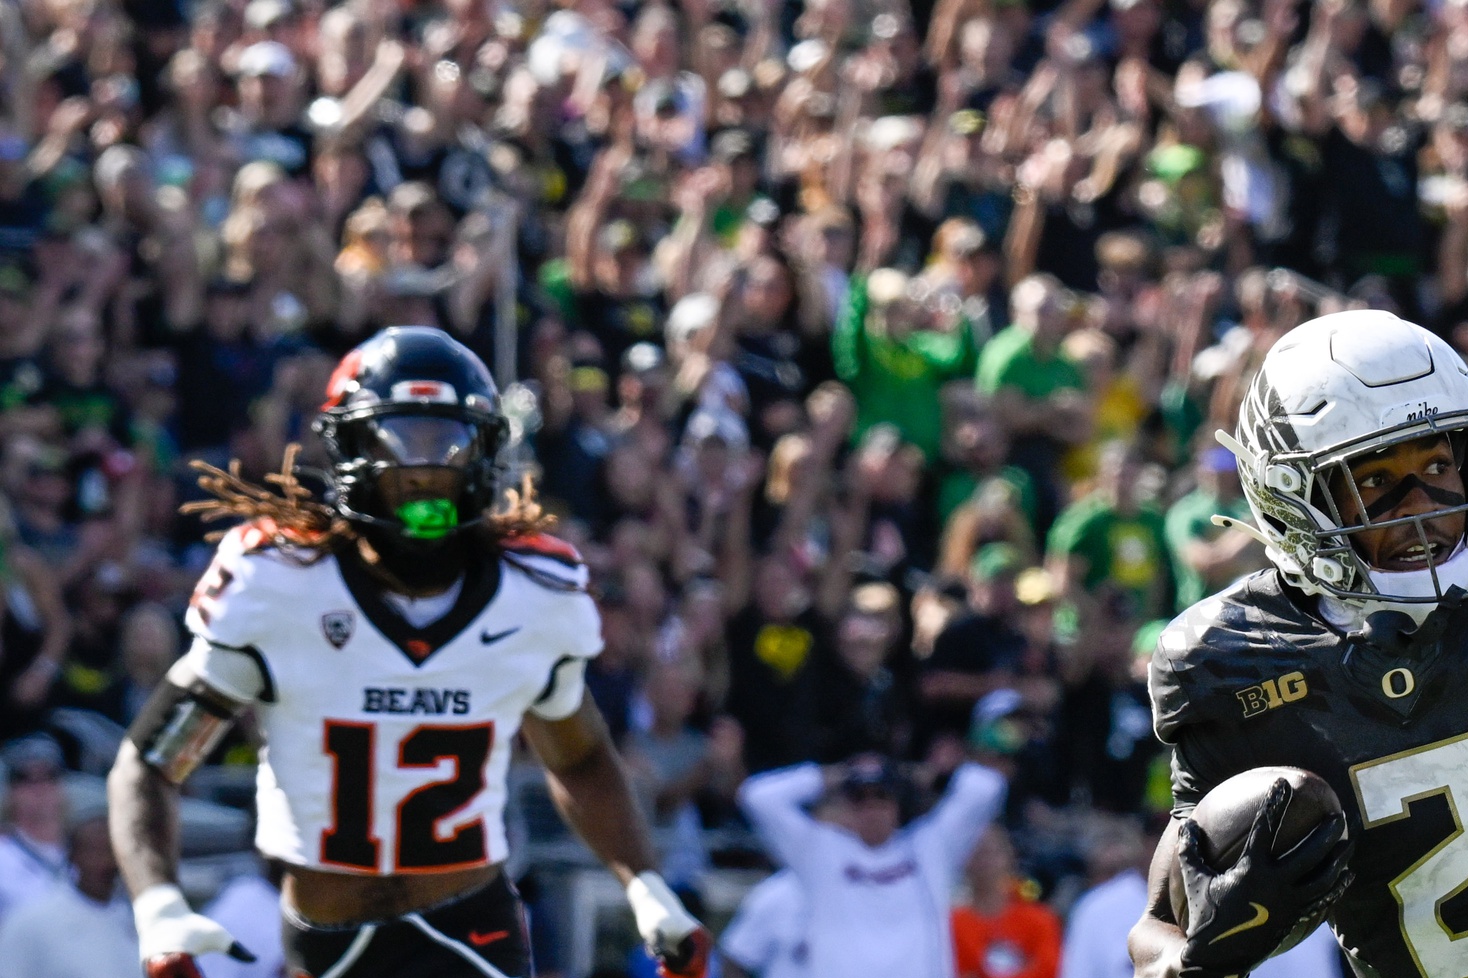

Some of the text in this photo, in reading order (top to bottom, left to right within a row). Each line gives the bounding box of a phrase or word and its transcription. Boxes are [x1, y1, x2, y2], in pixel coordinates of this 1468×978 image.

[1381, 667, 1415, 699] O
[361, 687, 472, 715] BEAVS
[320, 719, 495, 875] 12
